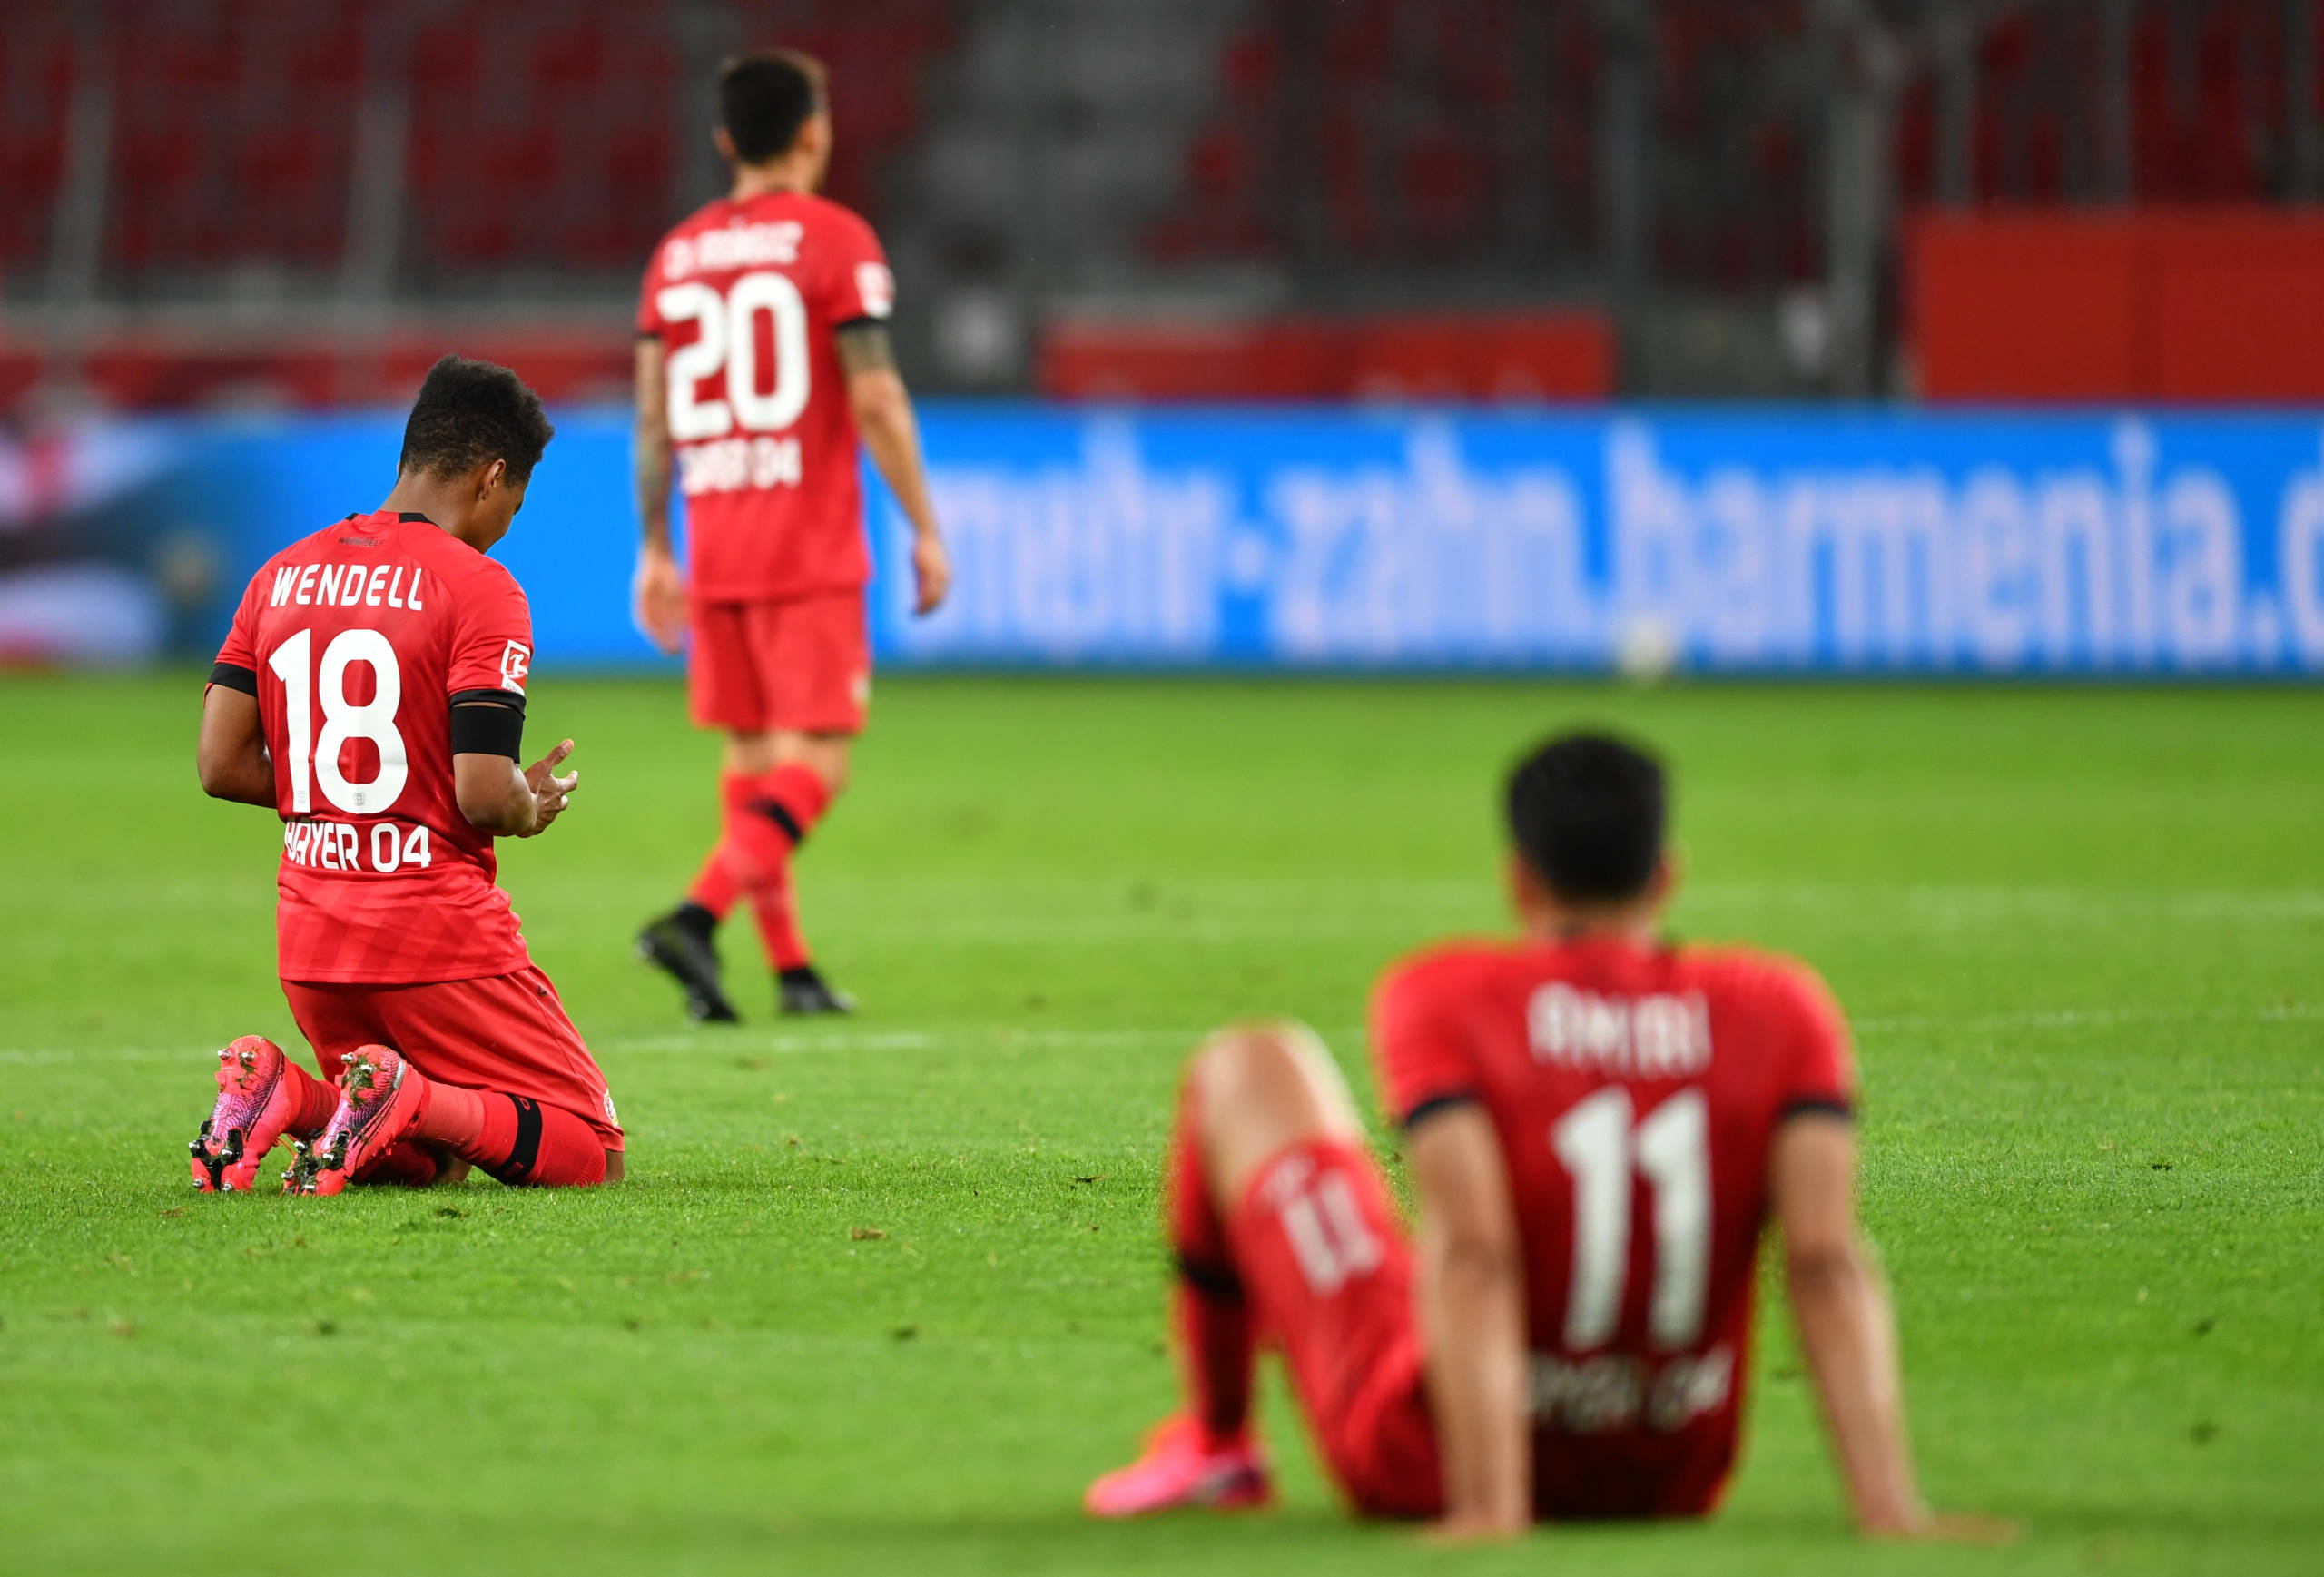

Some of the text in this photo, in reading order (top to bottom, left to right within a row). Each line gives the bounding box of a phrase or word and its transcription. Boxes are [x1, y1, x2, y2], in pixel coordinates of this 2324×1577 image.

[656, 271, 812, 441] 20
[271, 563, 423, 611] WENDELL
[267, 628, 409, 814] 18
[370, 823, 432, 872] 04
[1551, 1087, 1712, 1352] 11
